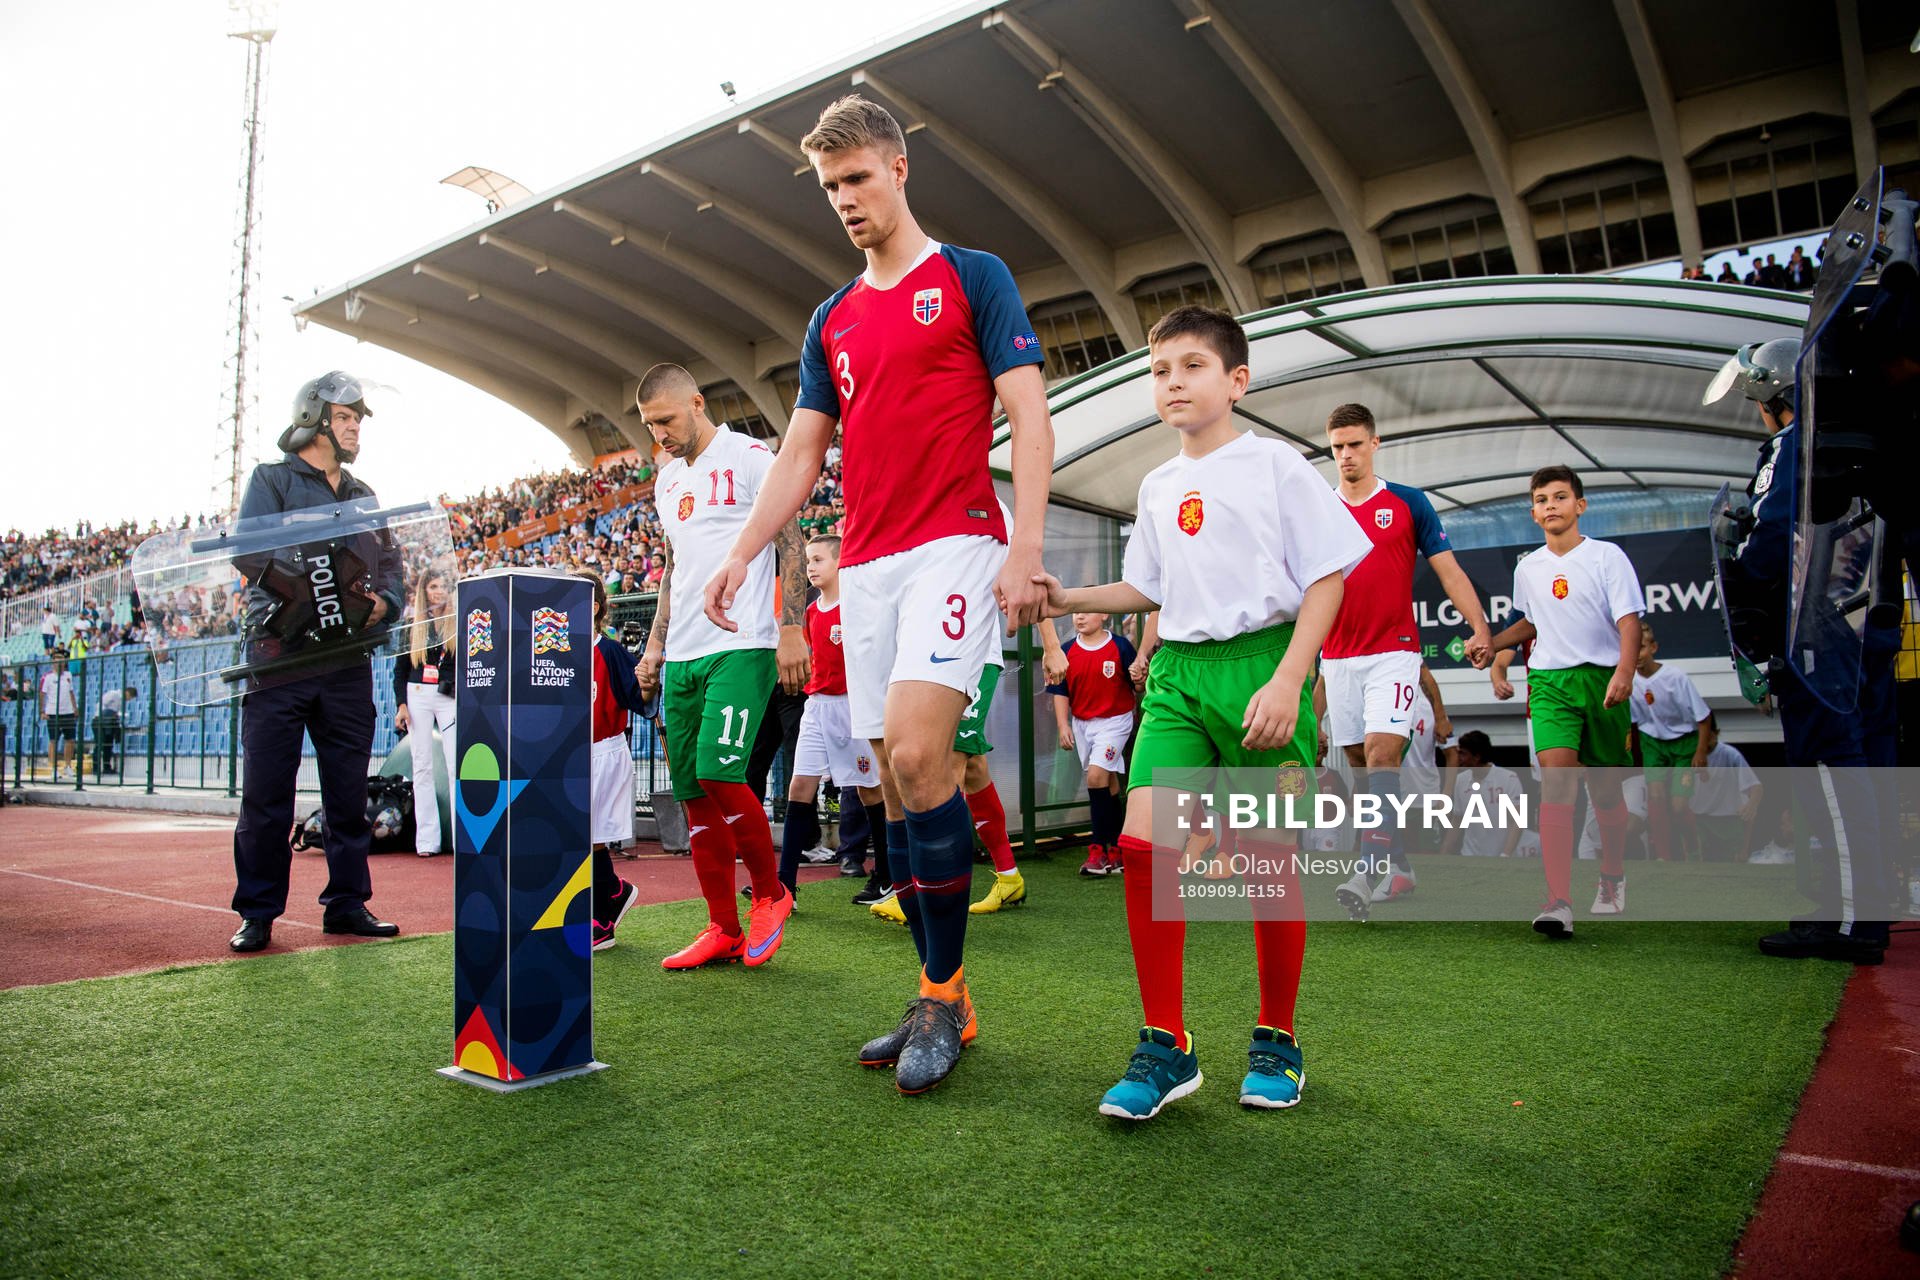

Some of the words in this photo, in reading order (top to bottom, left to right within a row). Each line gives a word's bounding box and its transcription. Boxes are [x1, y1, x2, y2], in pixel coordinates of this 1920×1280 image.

[836, 351, 854, 401] 3
[707, 468, 737, 506] 11
[307, 554, 344, 629] POLICE
[942, 593, 967, 641] 3
[467, 667, 496, 678] NATIONS
[469, 660, 483, 668] UEFA
[531, 667, 575, 678] NATIONS
[536, 659, 556, 667] UEFA
[467, 677, 492, 688] LEAGUE
[531, 676, 570, 687] LEAGUE
[1393, 682, 1414, 712] 19
[717, 705, 749, 748] 11
